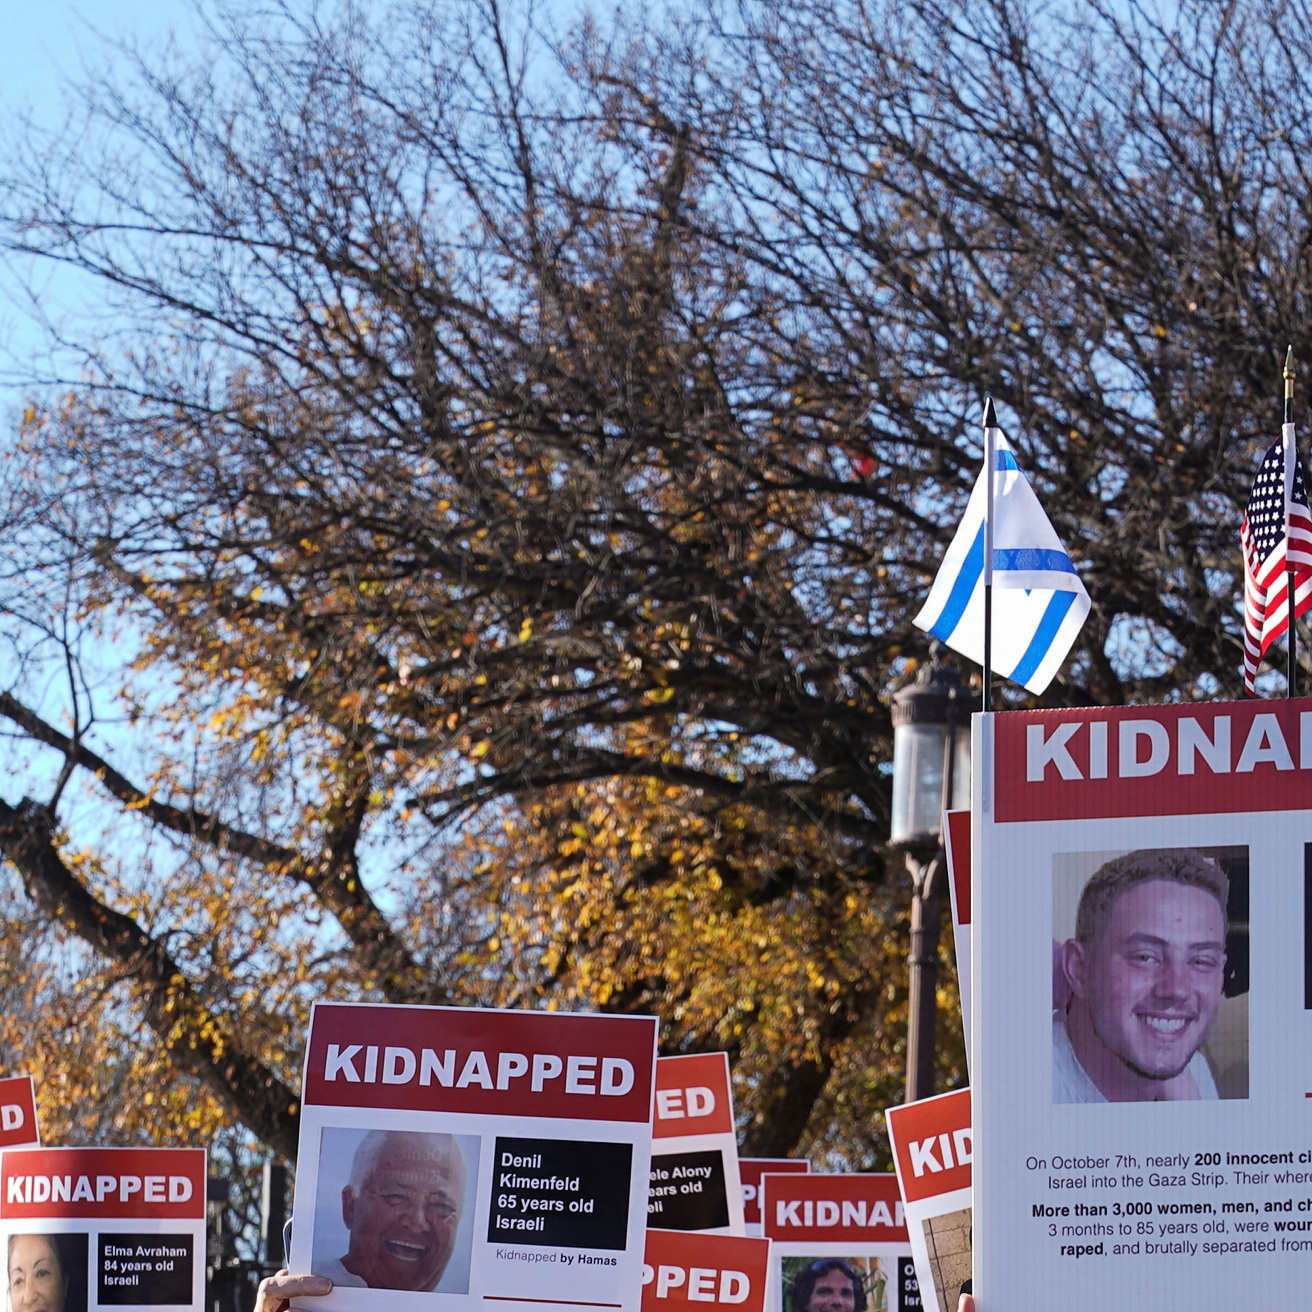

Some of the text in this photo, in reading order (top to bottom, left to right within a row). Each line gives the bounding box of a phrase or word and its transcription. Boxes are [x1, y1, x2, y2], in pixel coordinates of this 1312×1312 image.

[324, 1044, 635, 1096] KIDNAPPED
[501, 1152, 542, 1169] Denil
[1026, 1156, 1047, 1170] On
[1051, 1155, 1110, 1170] October
[1115, 1154, 1141, 1169] 7th,
[1146, 1153, 1190, 1170] nearly
[1194, 1152, 1222, 1166] 200
[1226, 1151, 1294, 1166] innocent
[672, 1166, 712, 1179] Alony
[7, 1175, 192, 1204] KIDNAPPED
[499, 1173, 580, 1192] Kimenfeld
[497, 1193, 594, 1213] 65 years old
[496, 1214, 545, 1231] Israeli
[104, 1245, 187, 1257] Elma Avraham
[496, 1249, 617, 1266] Kidnapped by Hamas
[104, 1260, 174, 1274] 84 years old
[104, 1274, 139, 1286] Israeli
